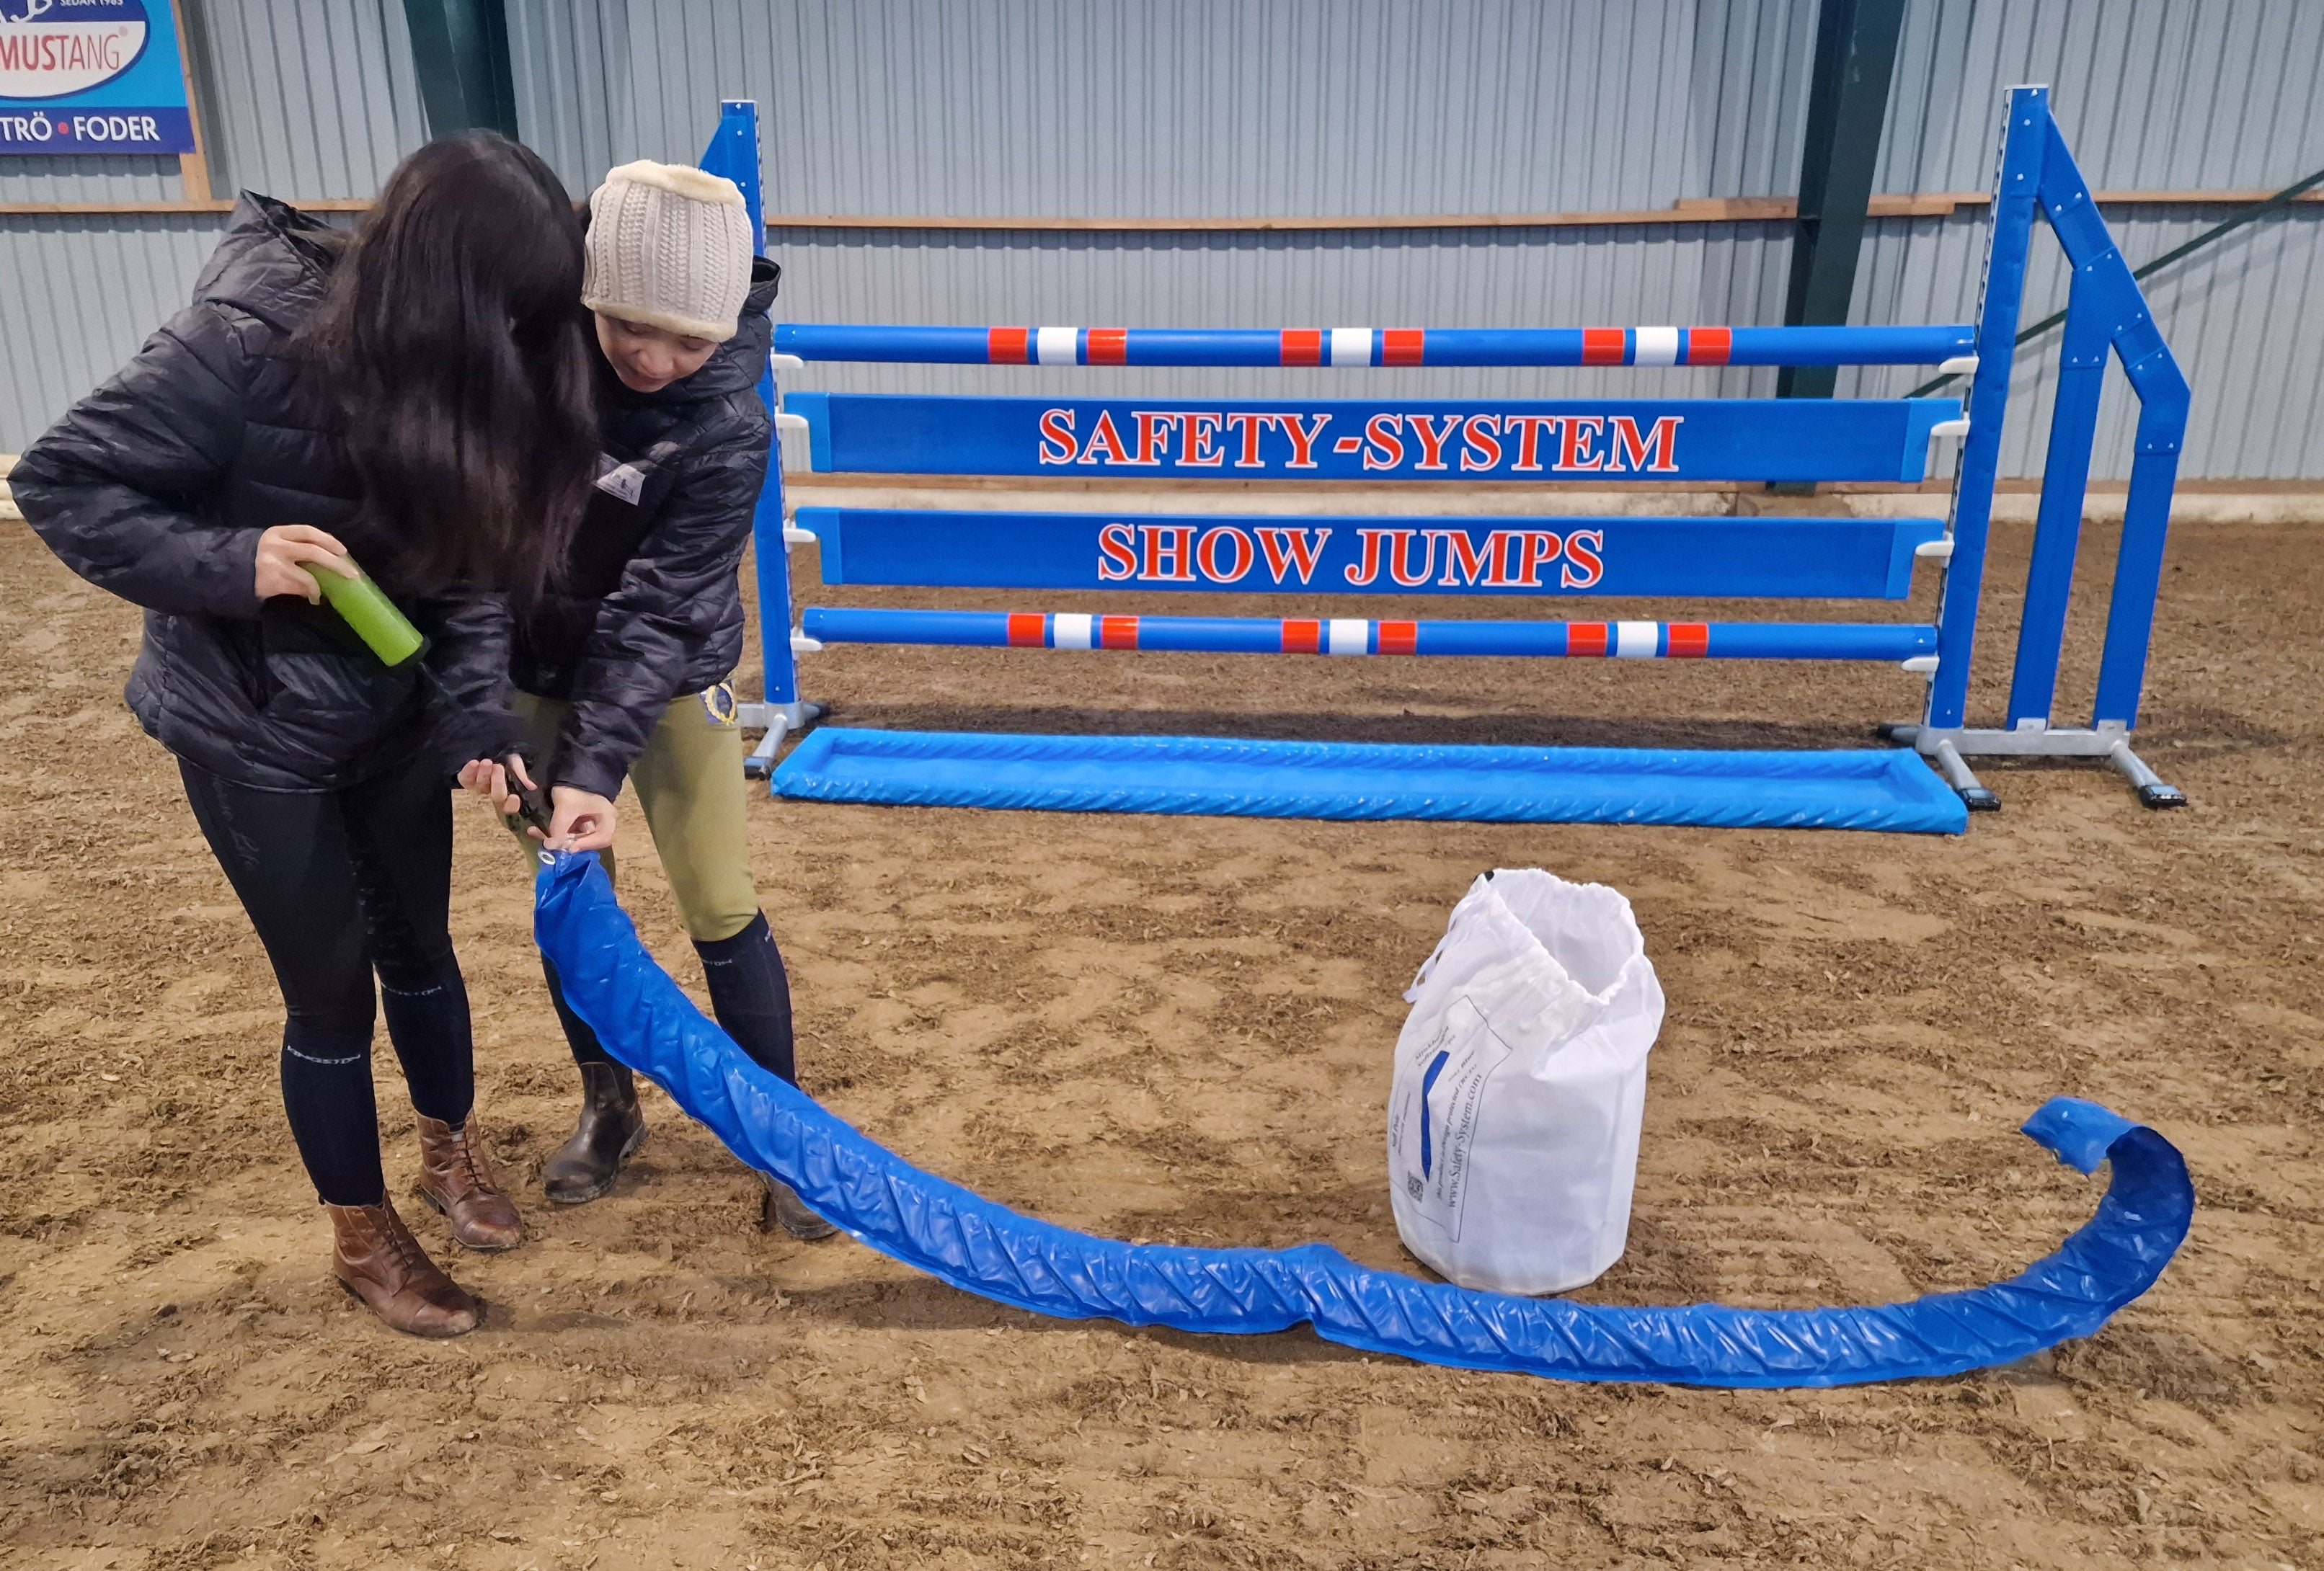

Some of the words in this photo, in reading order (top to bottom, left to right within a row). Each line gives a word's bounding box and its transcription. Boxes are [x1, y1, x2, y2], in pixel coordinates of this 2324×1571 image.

[0, 34, 120, 71] MUSTANG
[73, 116, 161, 141] FODER
[1039, 408, 1685, 472] SAFETY-SYSTEM
[1098, 523, 1333, 585] SHOW
[1344, 528, 1604, 589] JUMPS
[1447, 1073, 1482, 1208] www.Safety-System.com
